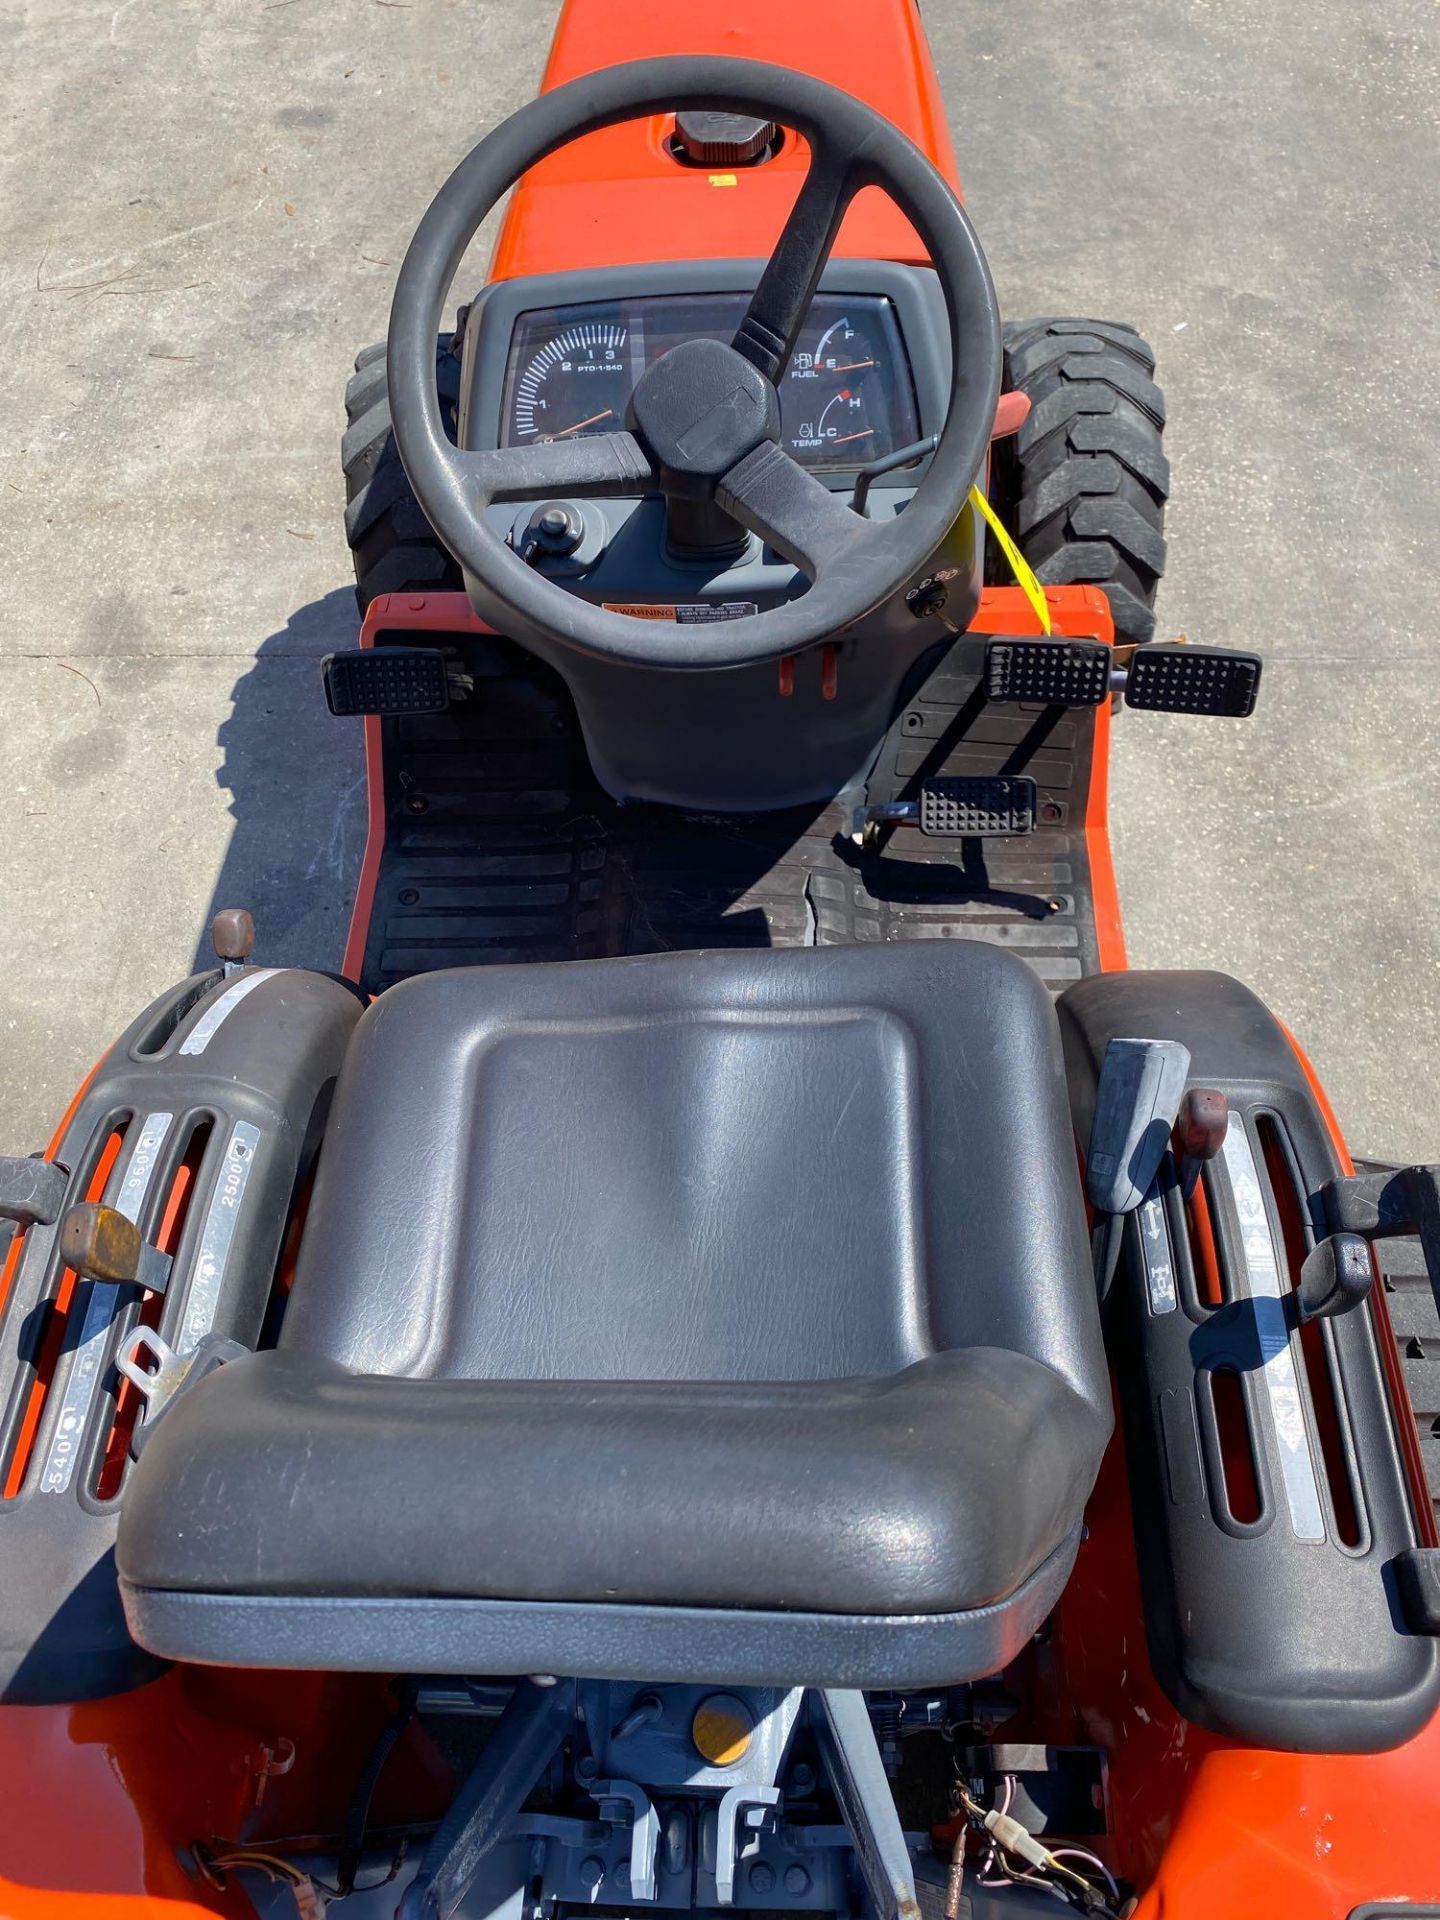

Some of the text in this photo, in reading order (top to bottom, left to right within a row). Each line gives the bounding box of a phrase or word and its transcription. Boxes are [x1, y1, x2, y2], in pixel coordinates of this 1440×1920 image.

[845, 330, 854, 339] F
[605, 350, 615, 359] 3
[561, 362, 572, 371] 2
[826, 359, 836, 368] E
[539, 400, 547, 408] 1
[849, 398, 861, 407] H
[826, 428, 837, 436] C
[619, 607, 674, 617] WARNING
[128, 1155, 149, 1188] 960
[222, 1163, 243, 1208] 2500
[49, 1442, 71, 1484] 540
